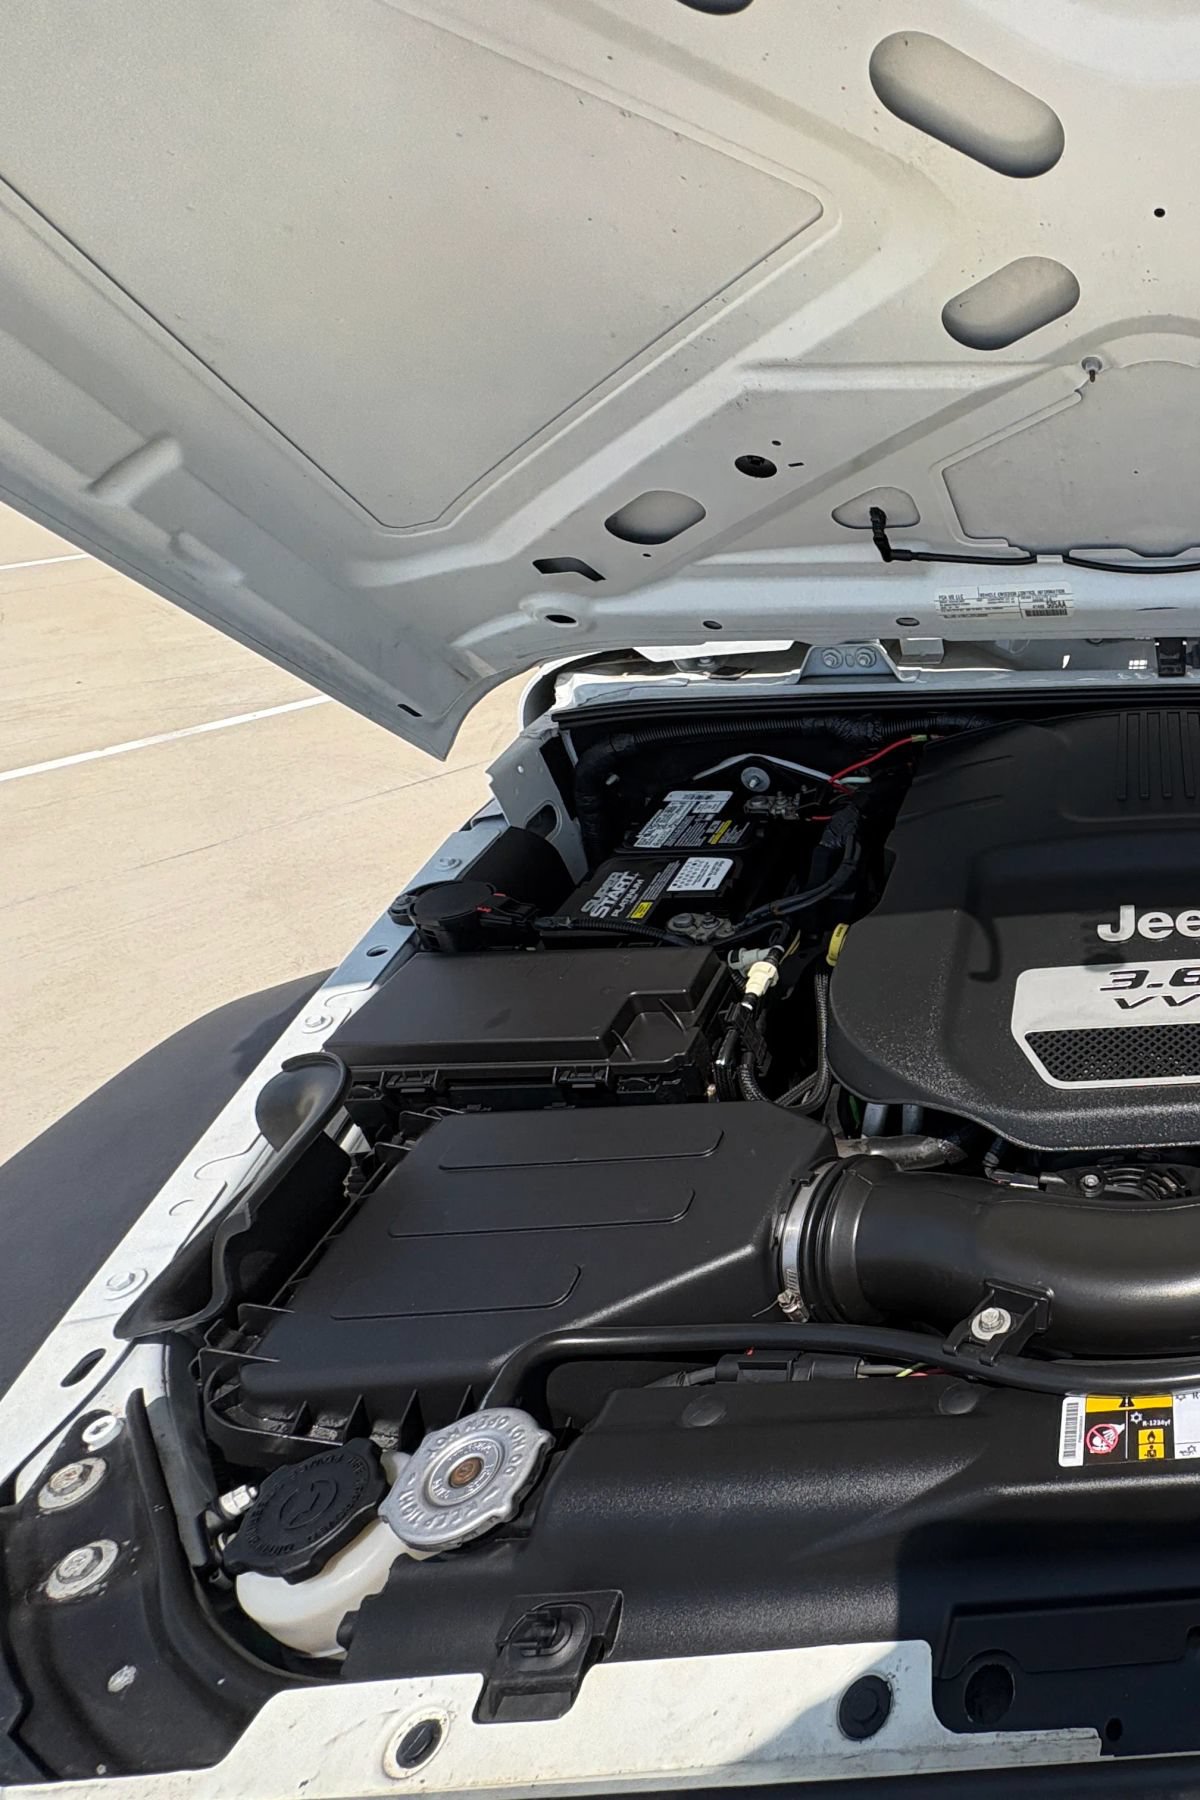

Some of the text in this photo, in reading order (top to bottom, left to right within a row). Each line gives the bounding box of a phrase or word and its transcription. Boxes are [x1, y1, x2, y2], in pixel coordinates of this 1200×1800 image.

[590, 871, 635, 919] START
[611, 879, 645, 917] PLATINUM
[464, 1414, 510, 1433] OPEN
